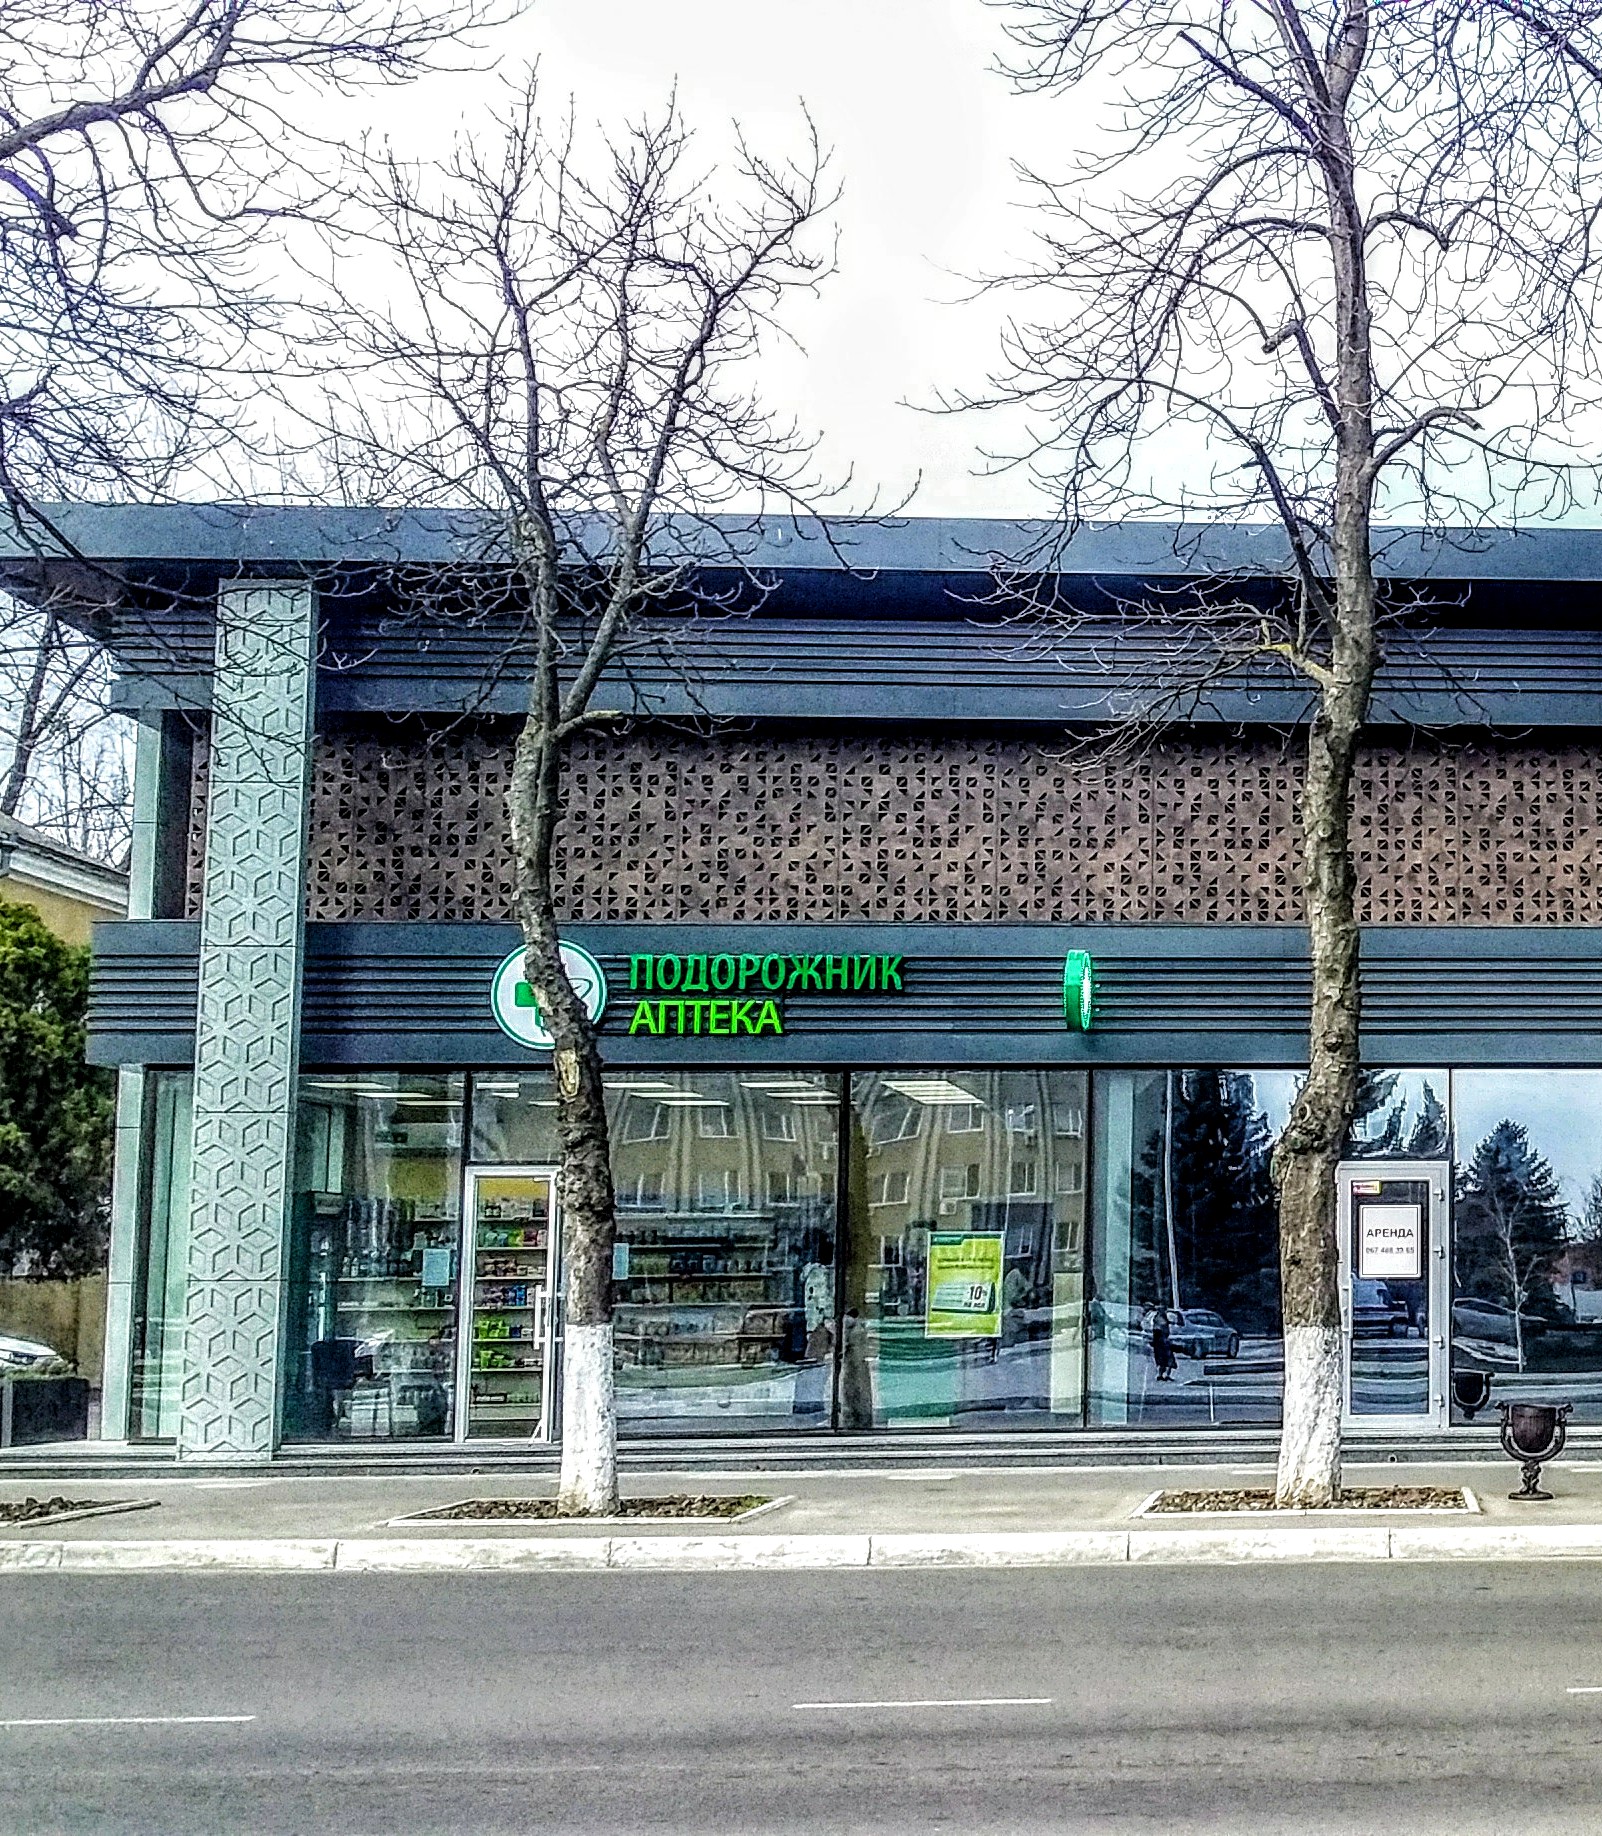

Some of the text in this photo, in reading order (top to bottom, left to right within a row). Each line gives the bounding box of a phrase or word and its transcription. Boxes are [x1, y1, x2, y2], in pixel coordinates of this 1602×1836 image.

[629, 953, 904, 991] ПОДОРОЖНИК
[629, 999, 783, 1034] АПТЕКА
[1366, 1228, 1414, 1239] АРЕНДА
